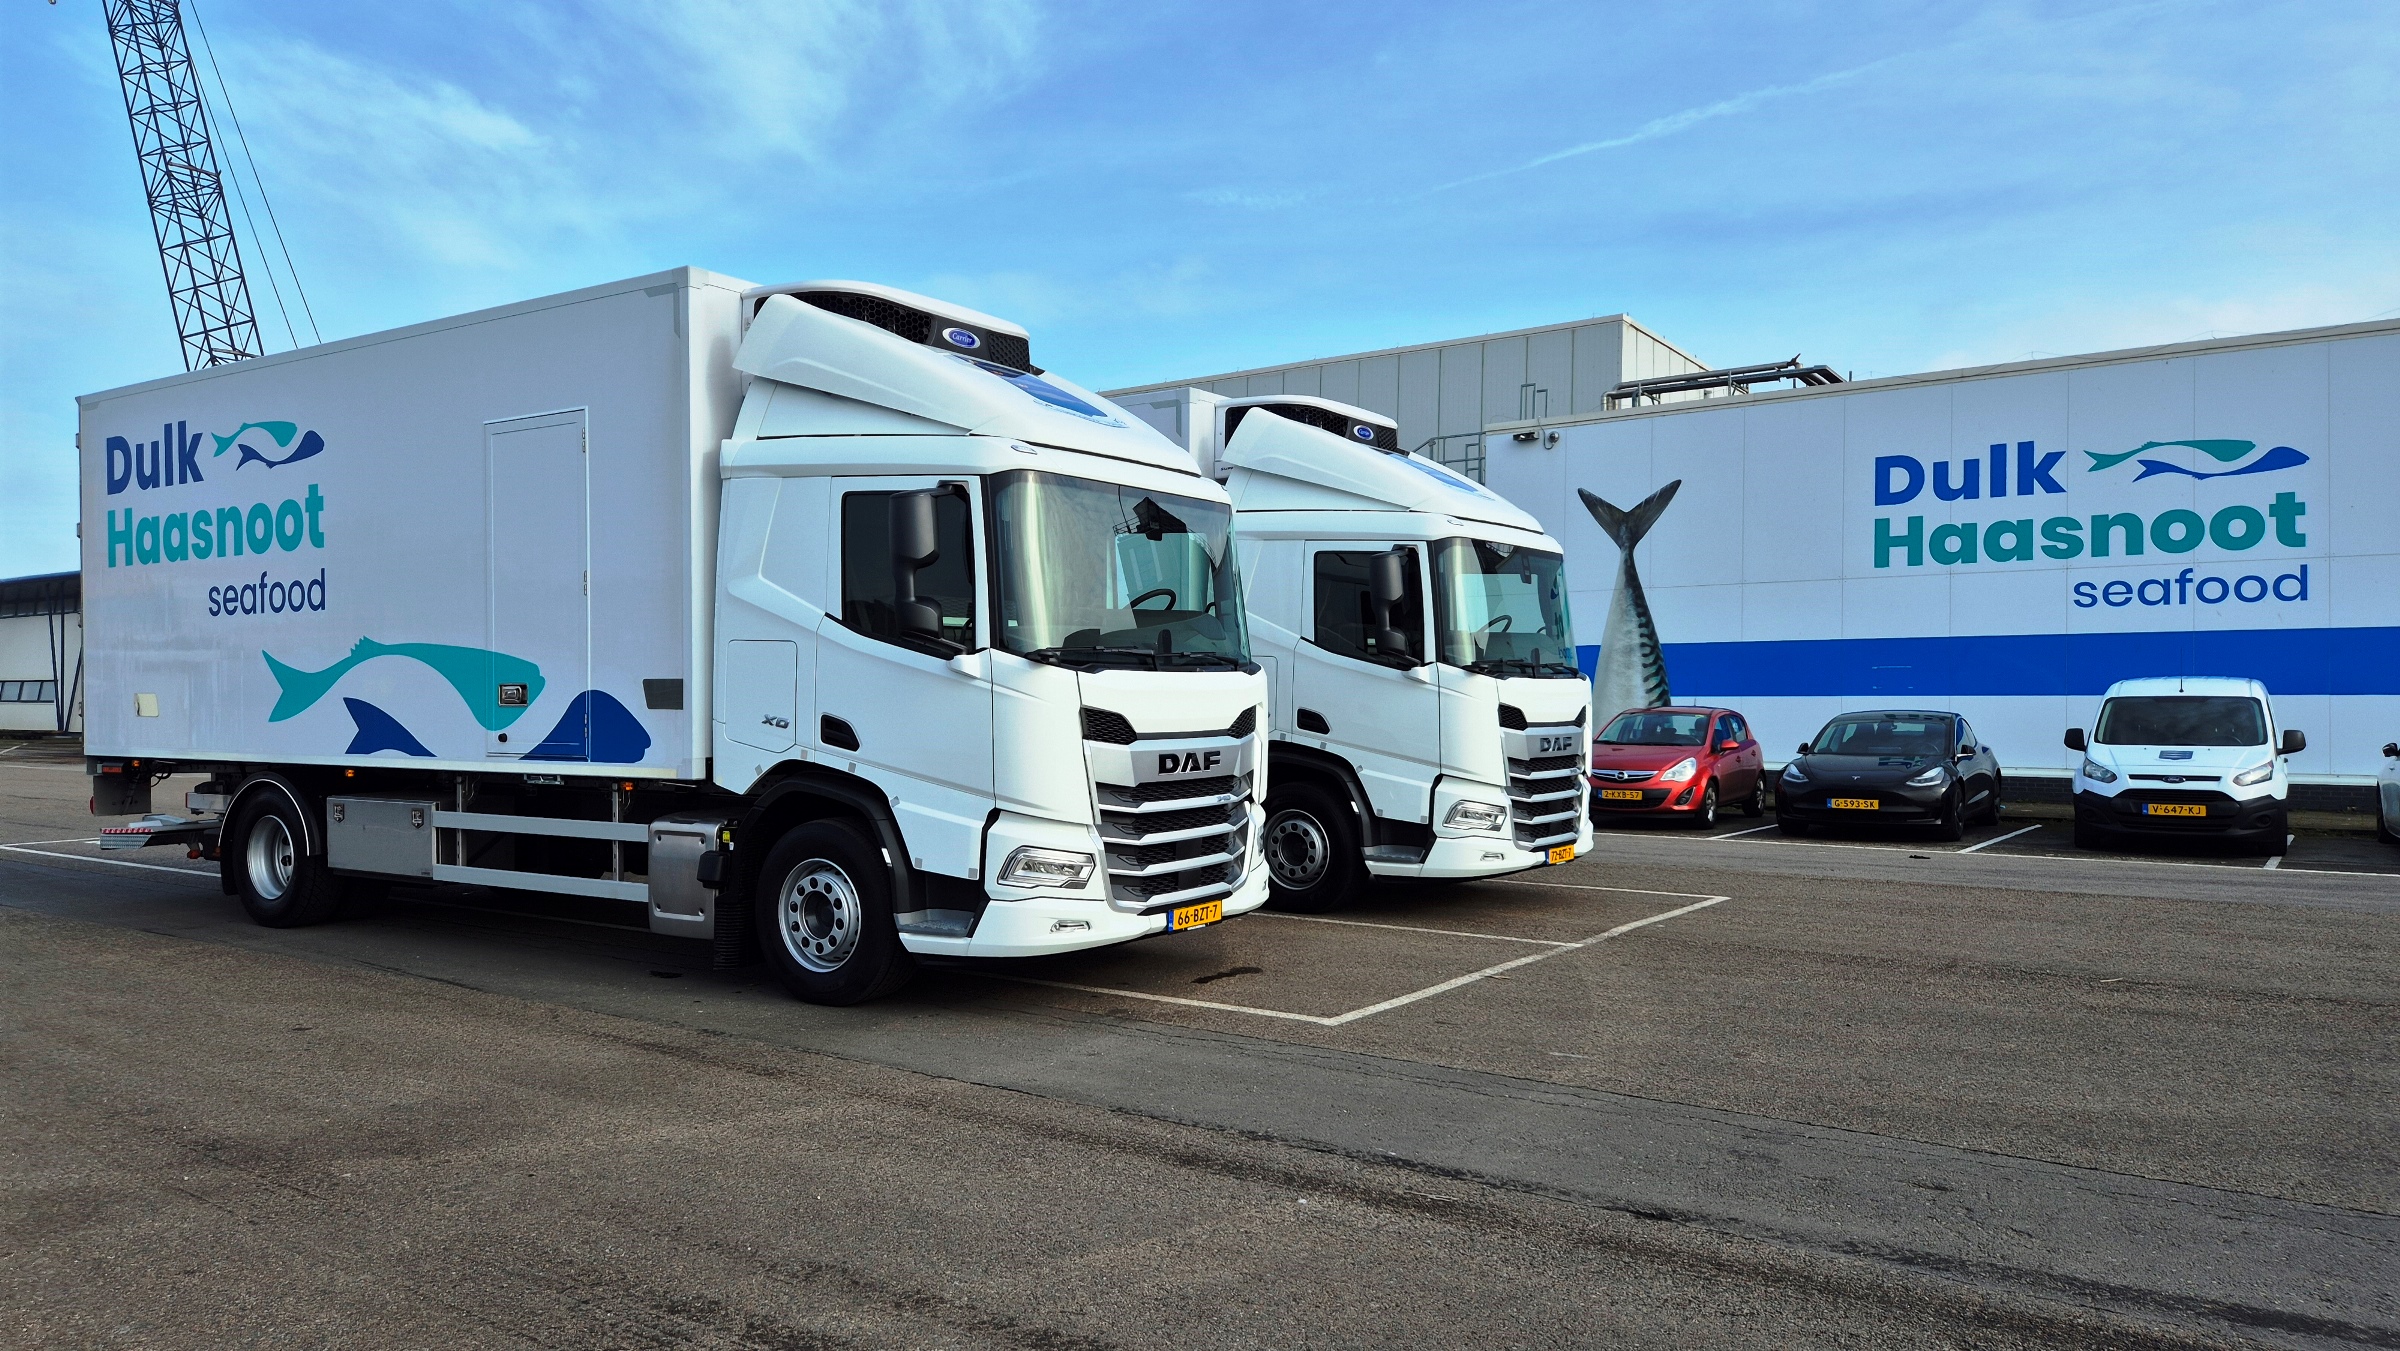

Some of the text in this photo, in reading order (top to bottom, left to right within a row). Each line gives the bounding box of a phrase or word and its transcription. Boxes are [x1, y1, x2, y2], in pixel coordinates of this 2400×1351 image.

[106, 420, 204, 496] Dulk
[1874, 440, 2067, 507] Dulk
[107, 483, 325, 569] Haasnoot
[1873, 491, 2307, 569] Haasnoot
[208, 567, 326, 617] seafood
[2072, 564, 2308, 608] seafood
[1158, 750, 1221, 775] DAF
[1540, 736, 1572, 752] DAF
[1834, 799, 1876, 808] G-593-SK
[2152, 805, 2201, 815] V-647-KJ
[1178, 904, 1218, 926] 66-BZT-7
